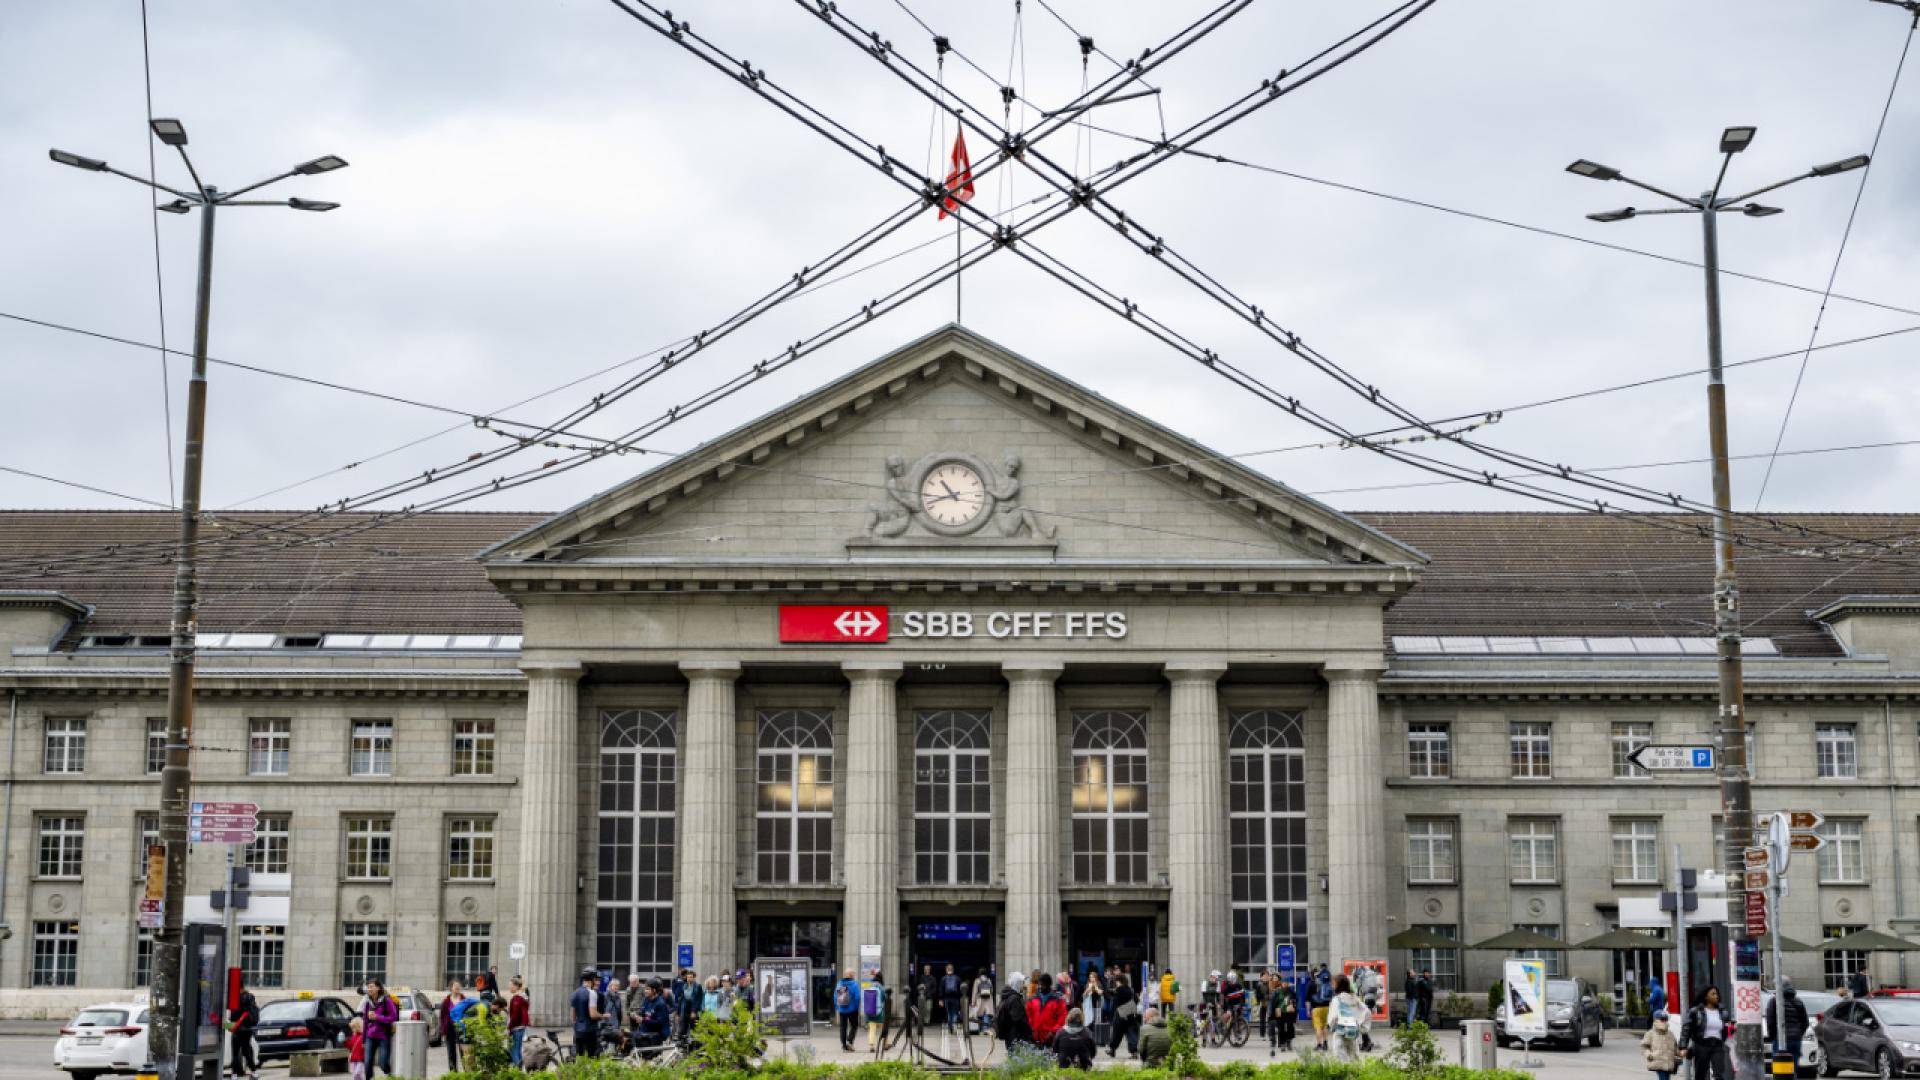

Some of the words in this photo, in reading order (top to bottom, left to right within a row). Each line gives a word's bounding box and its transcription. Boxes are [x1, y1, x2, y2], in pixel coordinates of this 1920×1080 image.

[902, 611, 973, 638] SBB
[987, 611, 1052, 638] CFF
[1066, 611, 1128, 638] FFS
[1697, 752, 1706, 765] P
